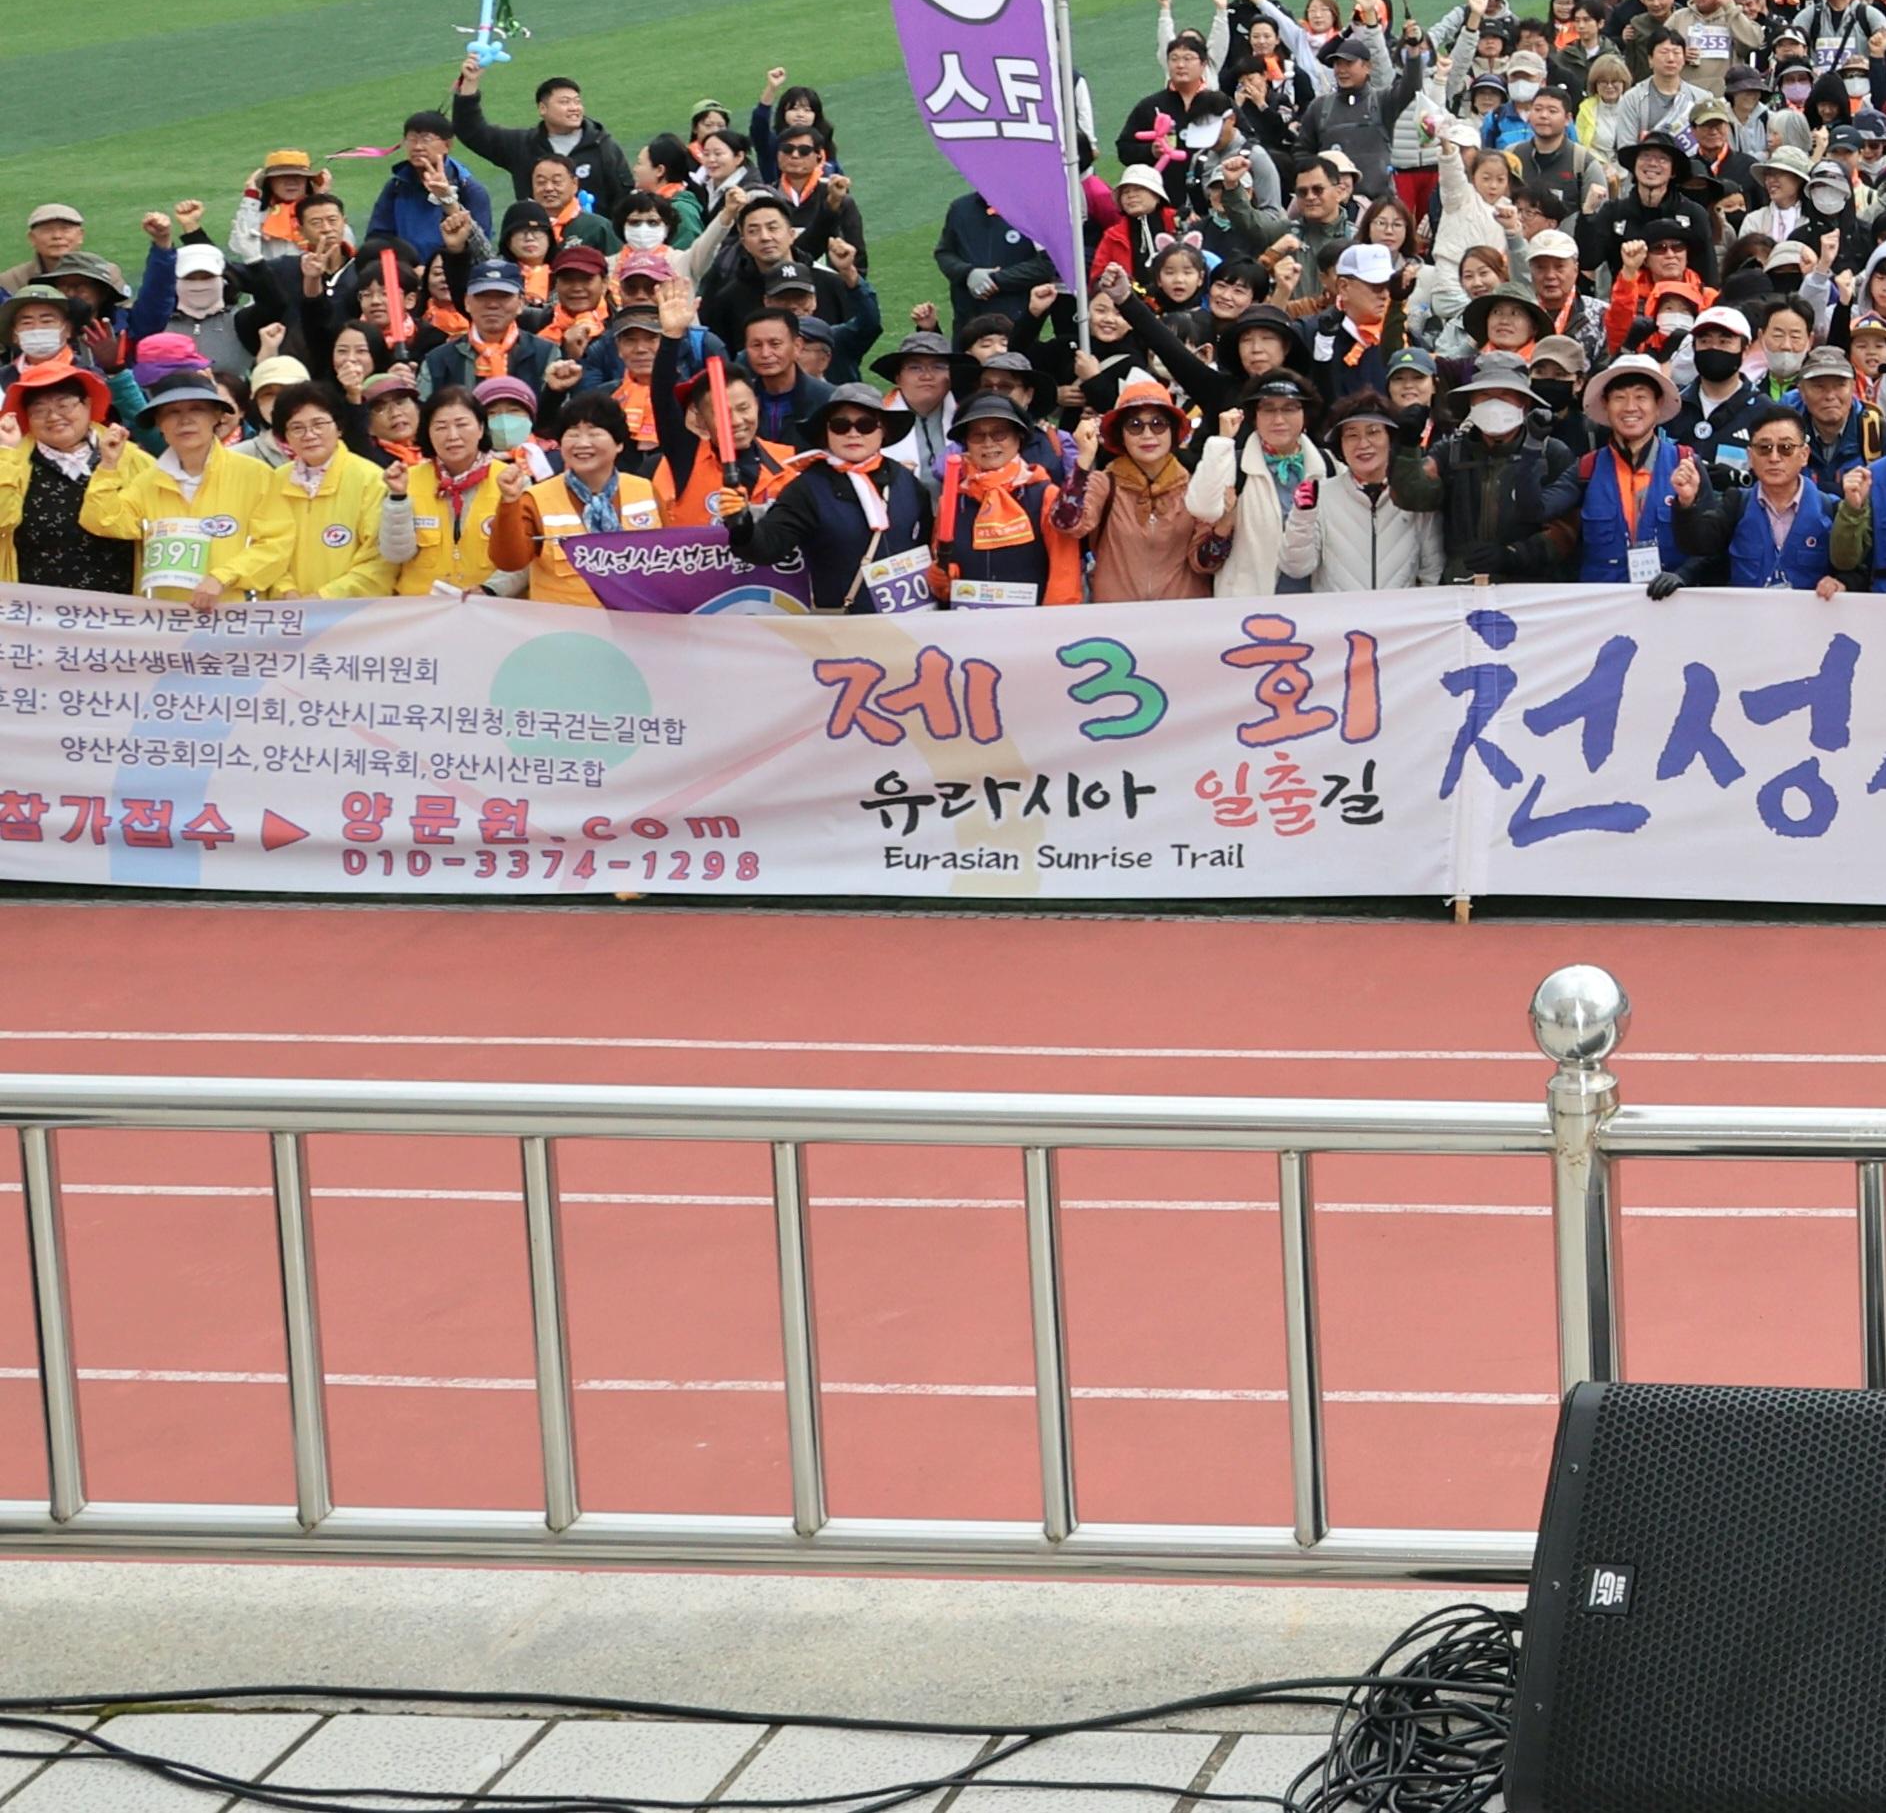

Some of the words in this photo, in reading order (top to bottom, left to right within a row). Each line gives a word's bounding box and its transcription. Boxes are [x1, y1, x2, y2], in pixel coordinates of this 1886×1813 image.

[874, 573, 930, 614] 320
[55, 604, 305, 637] 양산도시문화연구원
[54, 644, 439, 685] 천성산생태숲길걷기축제위원회
[814, 645, 1002, 747] 제
[1056, 636, 1169, 742] 3
[1220, 613, 1382, 747] 회
[859, 768, 1157, 837] 유라시아
[1194, 751, 1385, 837] 일출길
[0, 791, 236, 851] 참가접수
[342, 848, 762, 883] 010-3374-1298
[884, 845, 1021, 872] Eurasian
[1037, 843, 1153, 870] Sunrise
[1170, 842, 1246, 870] Trail
